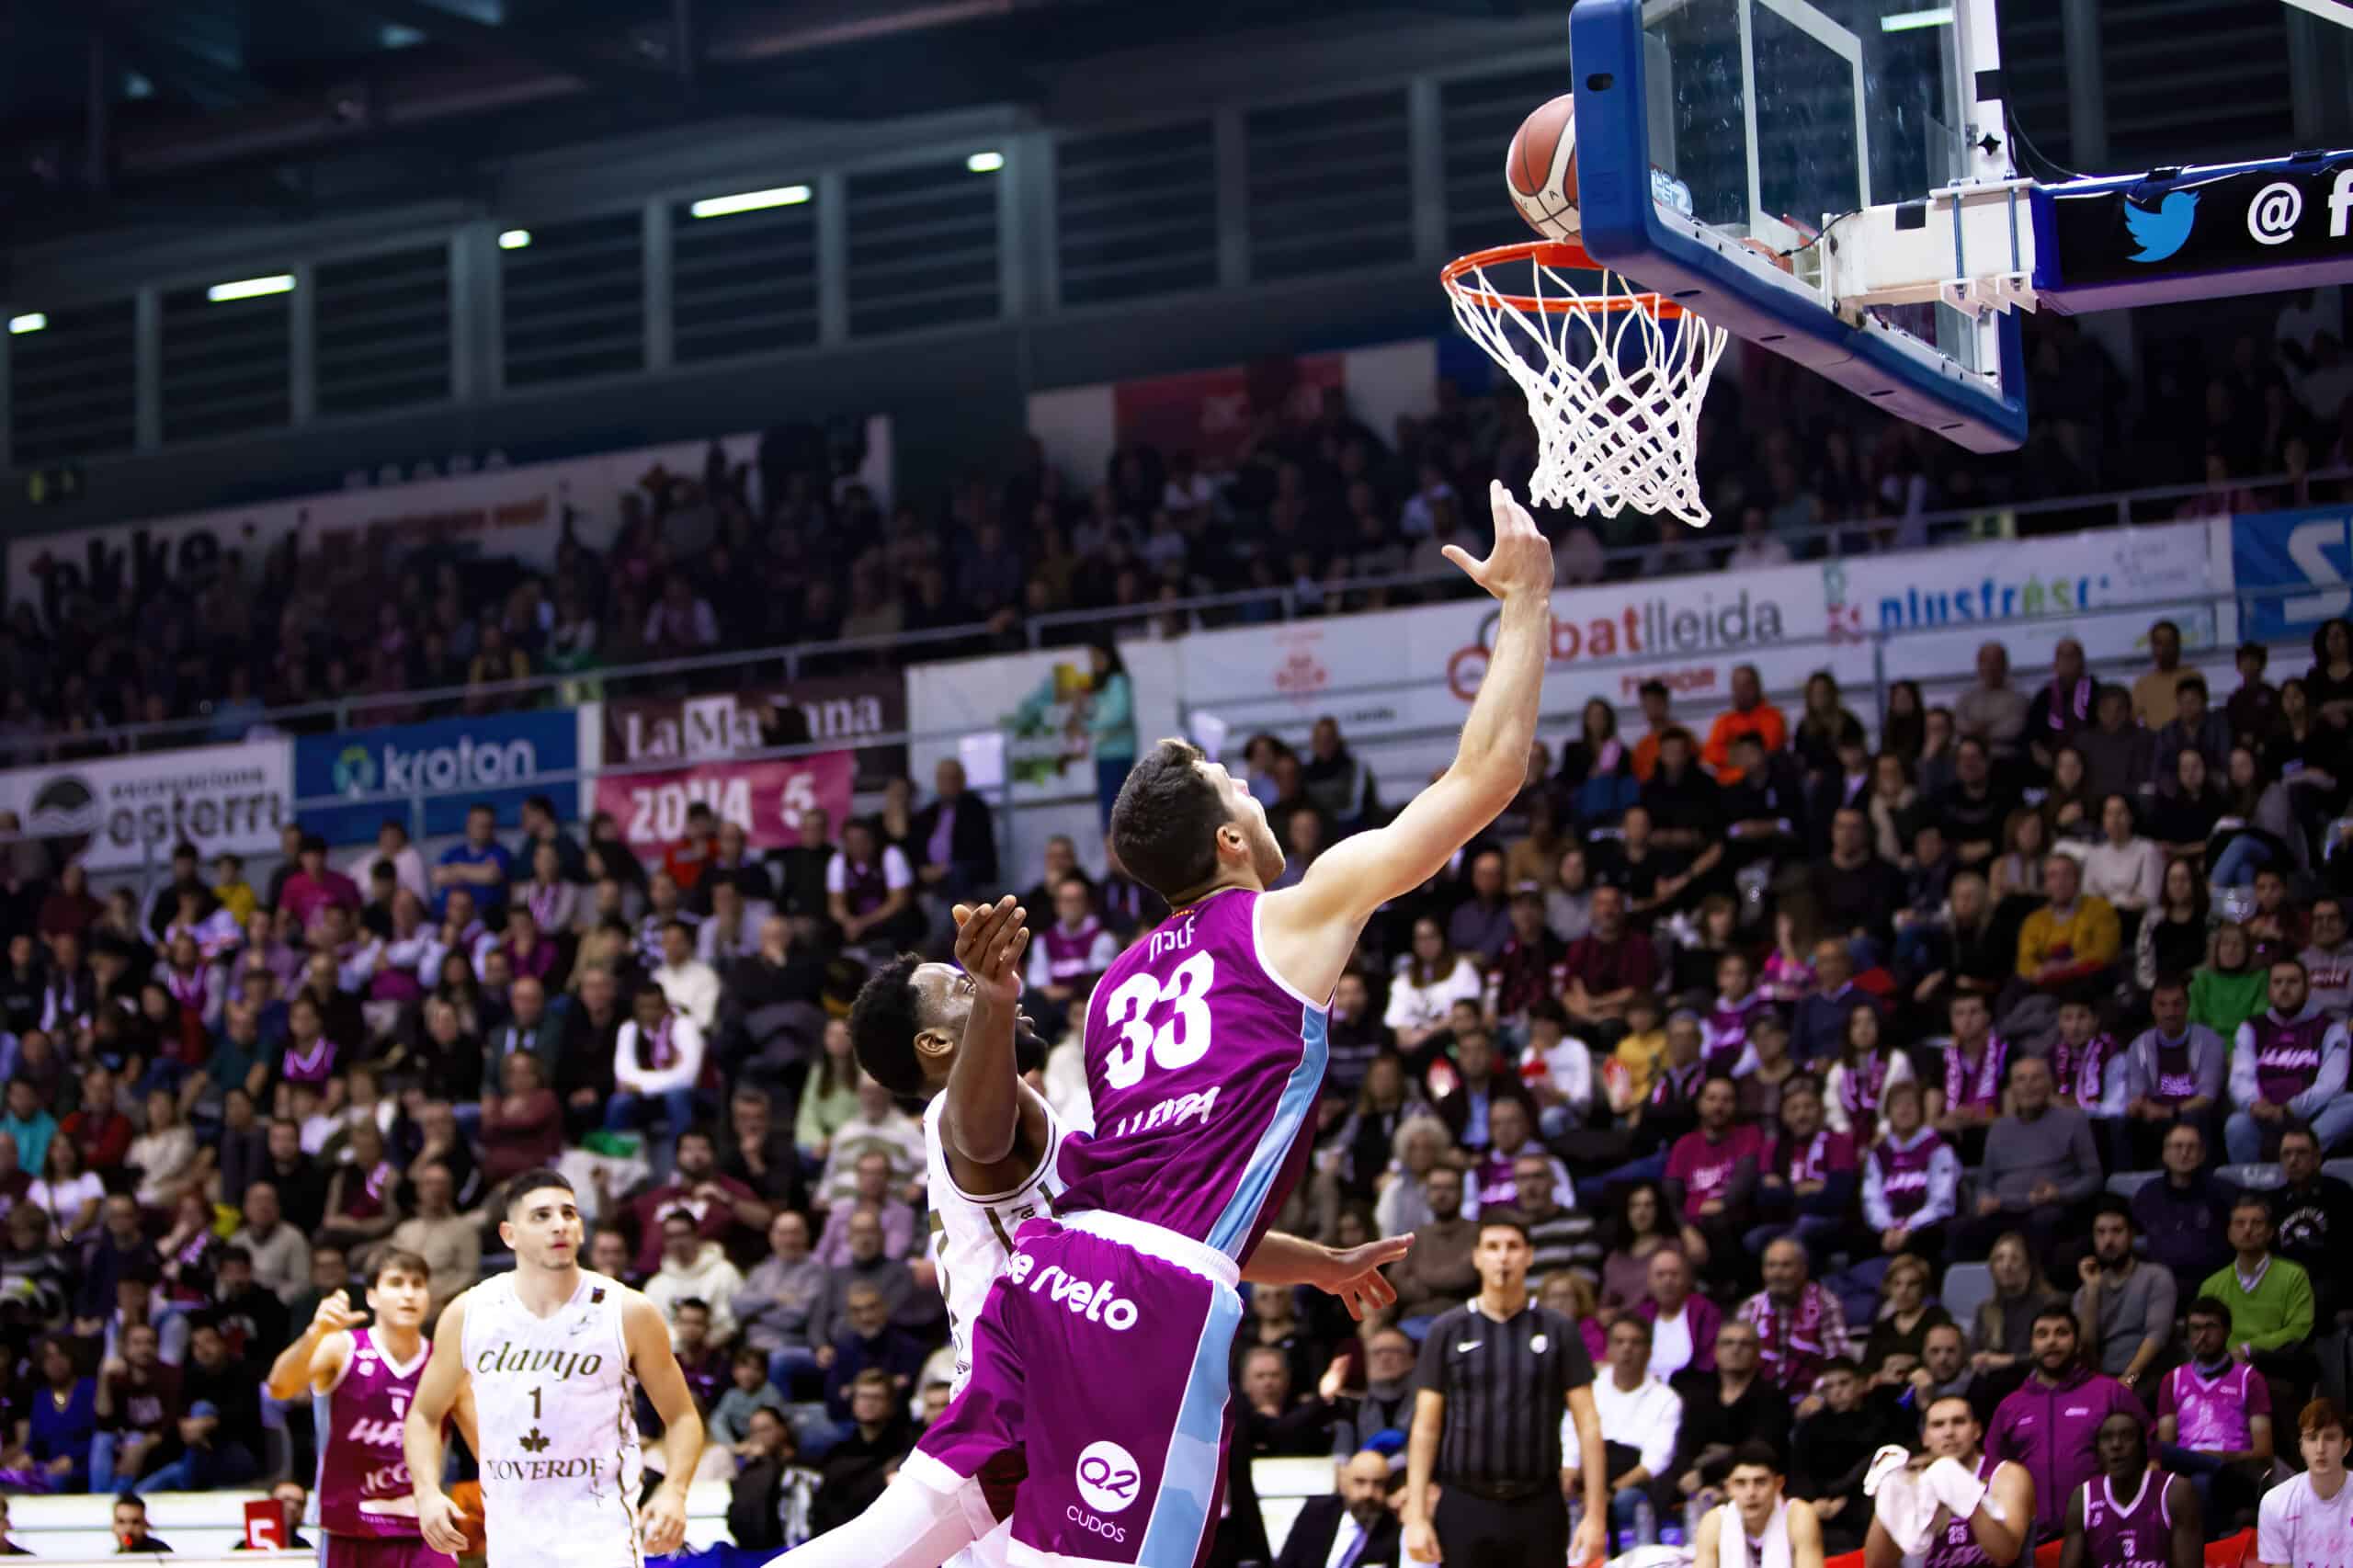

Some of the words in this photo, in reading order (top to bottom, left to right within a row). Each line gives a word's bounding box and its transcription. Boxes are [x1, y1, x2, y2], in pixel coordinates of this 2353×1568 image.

[382, 734, 537, 793] kroton
[1104, 949, 1215, 1090] 33
[477, 1340, 603, 1382] clavijo
[528, 1386, 541, 1420] 1
[1080, 1456, 1138, 1499] Q2
[249, 1518, 279, 1552] 5
